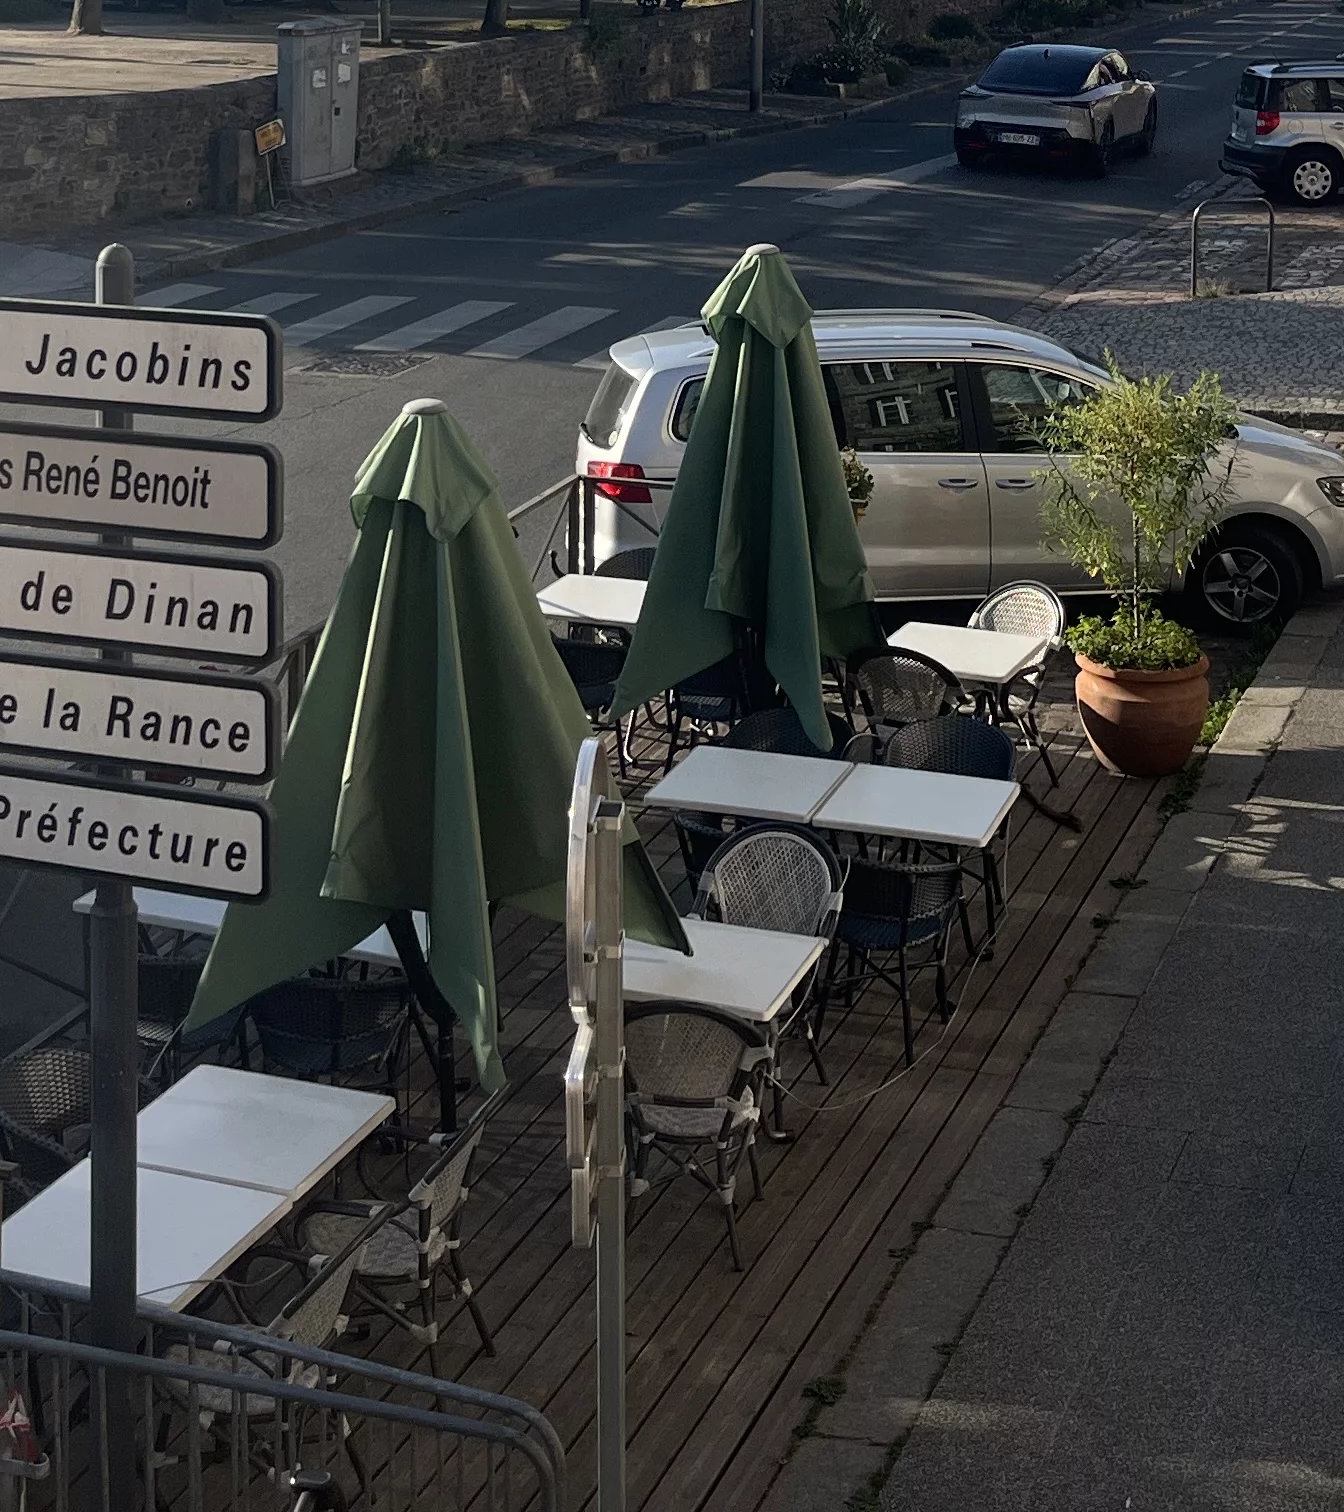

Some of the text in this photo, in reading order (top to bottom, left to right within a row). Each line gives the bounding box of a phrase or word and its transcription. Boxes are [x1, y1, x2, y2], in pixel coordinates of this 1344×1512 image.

[25, 333, 253, 393] Jacobins
[22, 449, 100, 498] René
[109, 458, 213, 510] Benoit
[19, 570, 75, 616] de
[104, 577, 255, 635] Dinan
[43, 688, 81, 734] la
[105, 696, 251, 754] Rance
